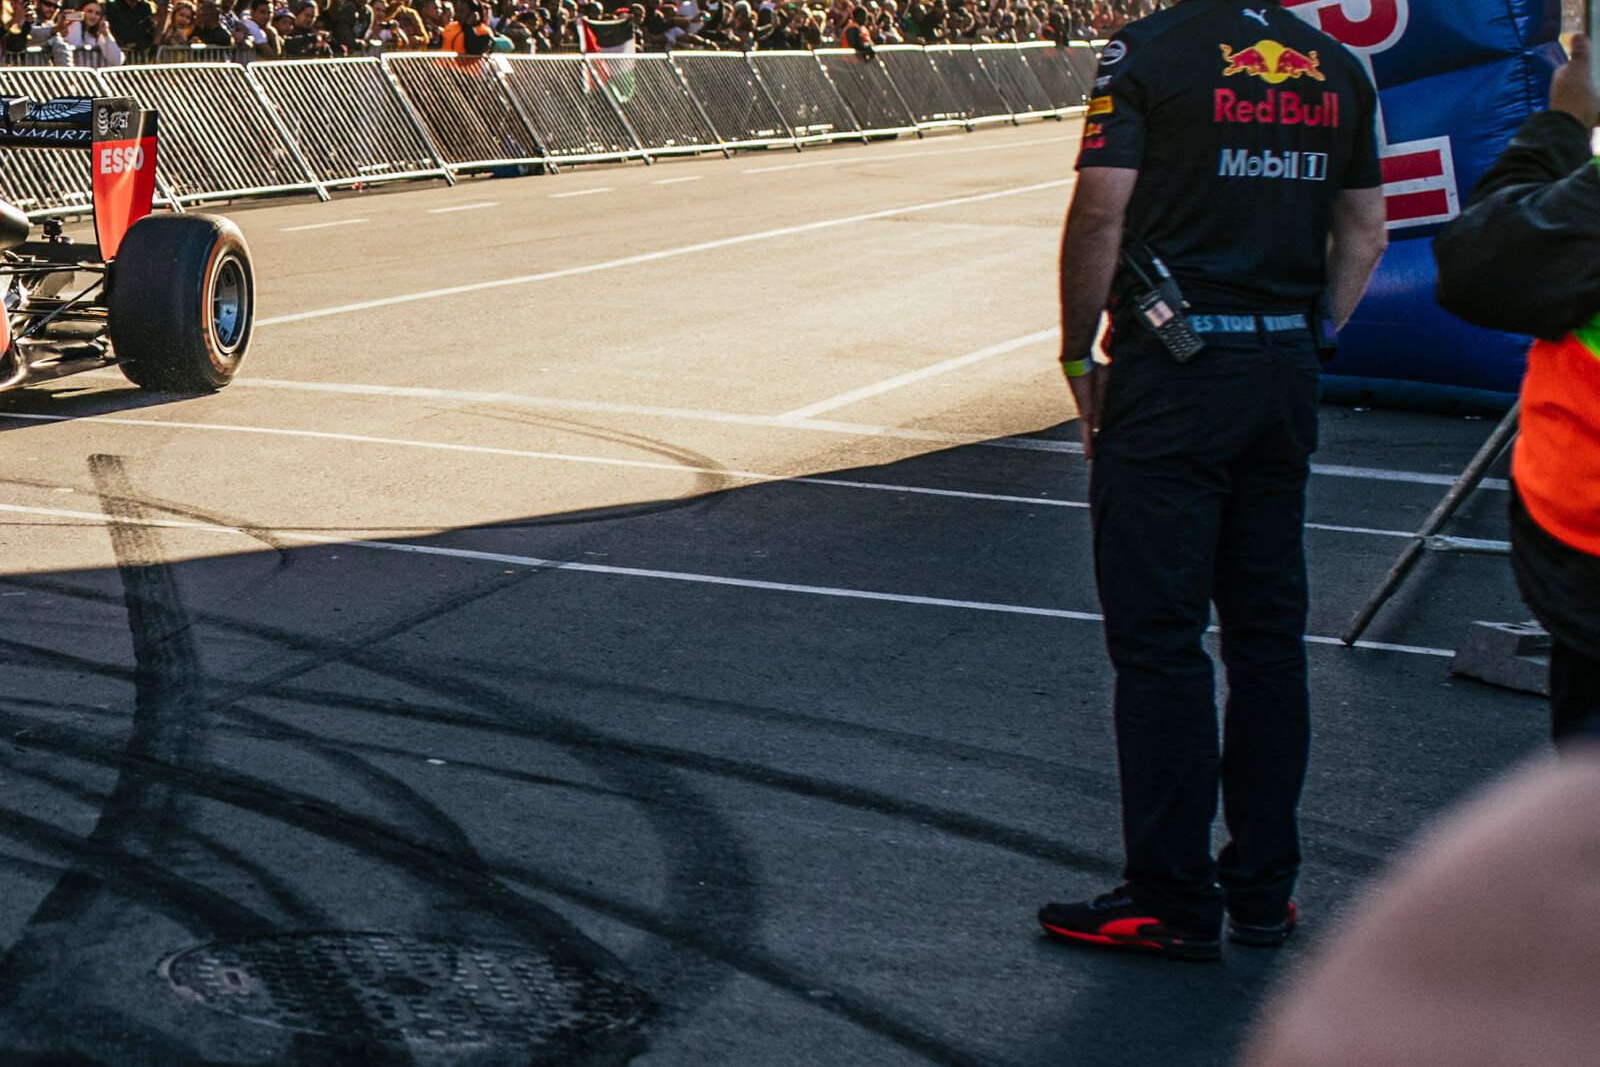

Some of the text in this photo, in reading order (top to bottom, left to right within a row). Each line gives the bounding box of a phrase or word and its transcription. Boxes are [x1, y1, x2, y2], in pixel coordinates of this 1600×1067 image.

[1215, 89, 1339, 127] Red Bull
[100, 147, 144, 174] ESSO
[1218, 149, 1299, 179] Mobil
